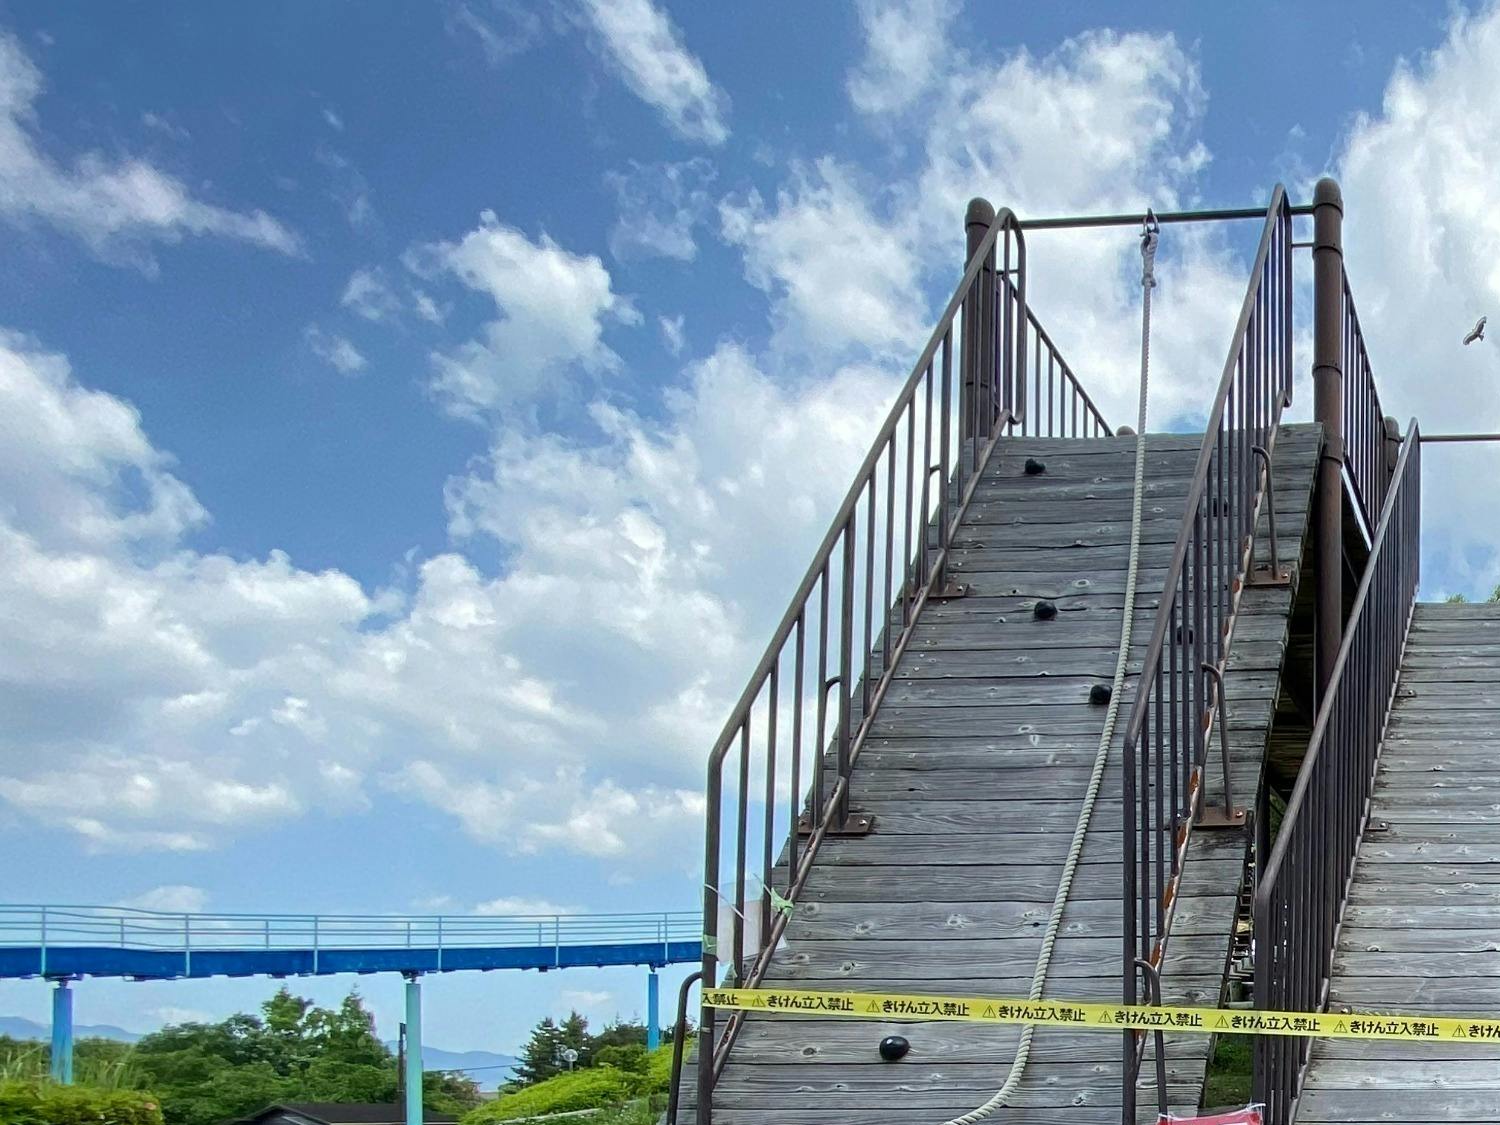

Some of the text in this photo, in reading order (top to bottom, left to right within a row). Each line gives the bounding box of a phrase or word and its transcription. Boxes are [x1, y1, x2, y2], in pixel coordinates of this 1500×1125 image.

[767, 994, 854, 1012] きけん立入禁止
[882, 999, 970, 1017] きけん立入禁止
[999, 1004, 1087, 1022] きけん立入禁止
[1114, 1010, 1203, 1027] きけん立入禁止
[1231, 1015, 1321, 1032] きけん立入禁止
[1349, 1020, 1439, 1037] きけん立入禁止
